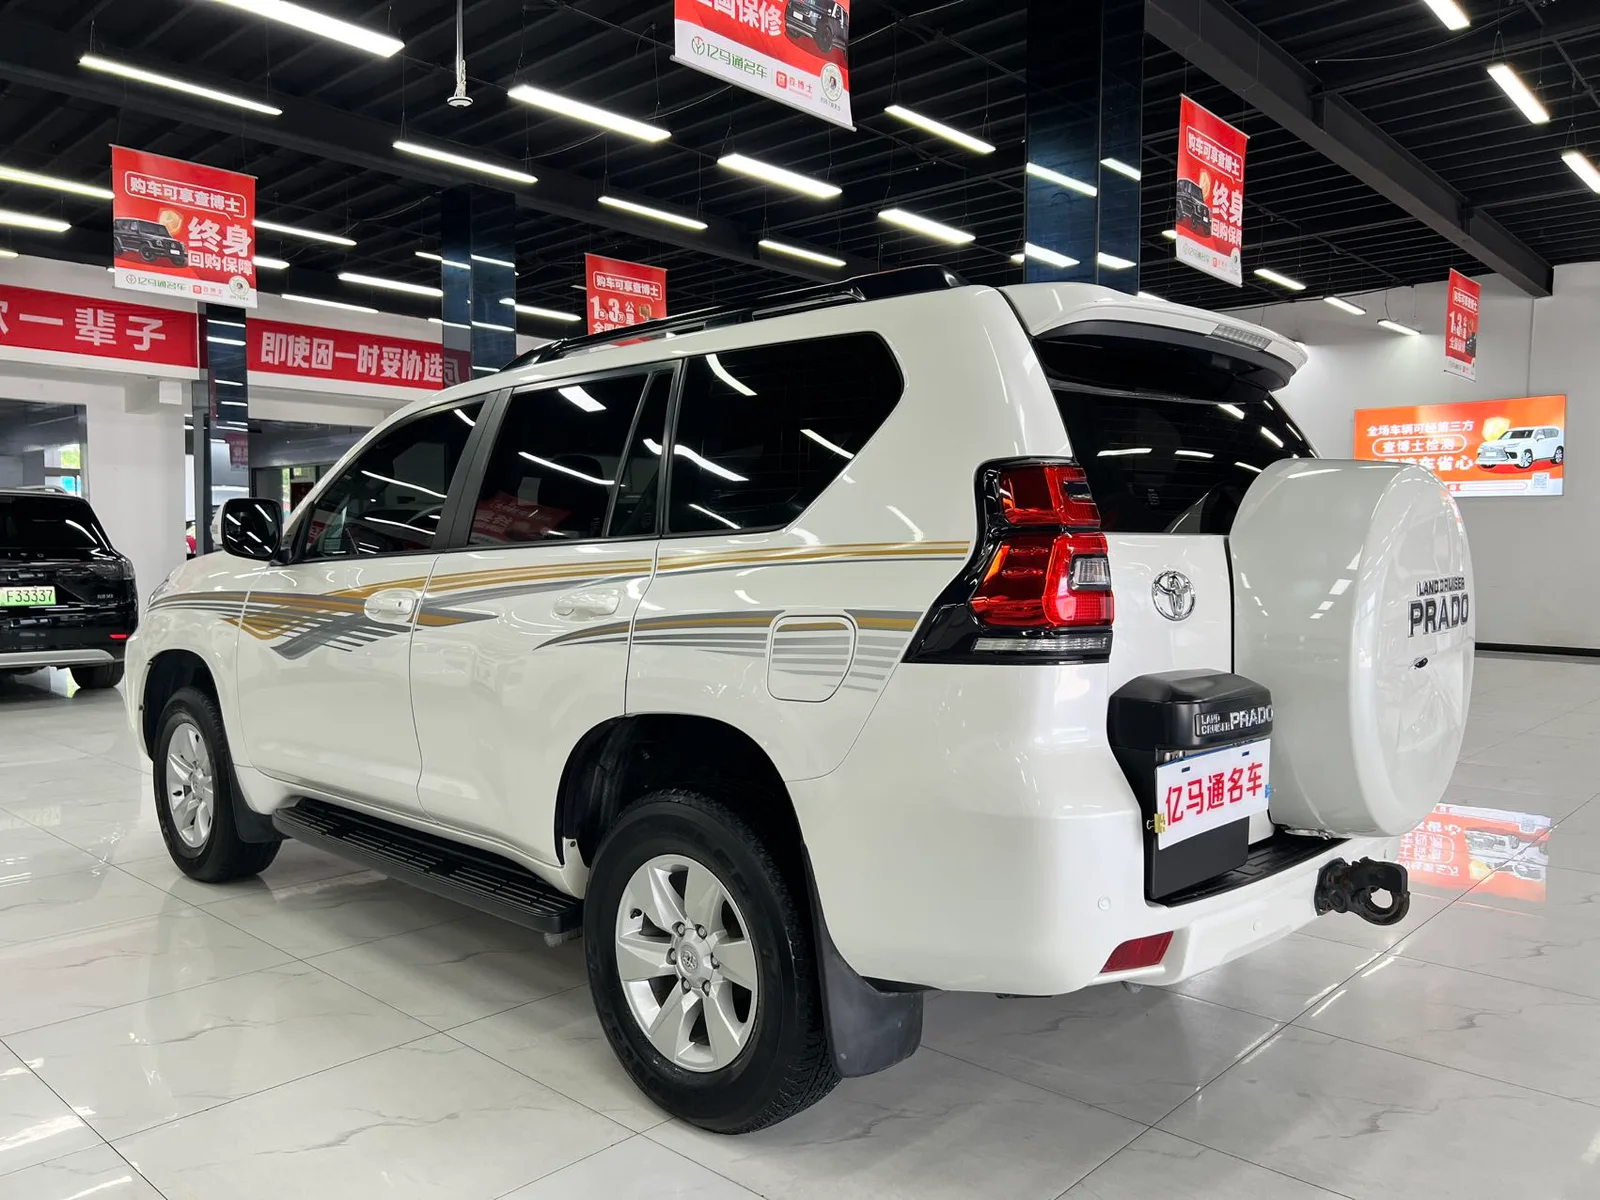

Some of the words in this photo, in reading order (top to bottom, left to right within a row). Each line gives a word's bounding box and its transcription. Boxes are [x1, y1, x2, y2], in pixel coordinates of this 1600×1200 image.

[697, 0, 782, 36] 国保修
[707, 43, 768, 79] 亿马通名车
[130, 177, 240, 213] 购车可享查博士
[188, 216, 252, 257] 终身
[187, 250, 253, 276] 回购保障
[0, 301, 166, 351] 一辈子
[7, 589, 53, 603] F33337
[1416, 580, 1439, 597] LAND
[1408, 593, 1469, 638] PRADO
[1230, 705, 1274, 730] PRADO
[1165, 762, 1263, 826] 亿马通名车
